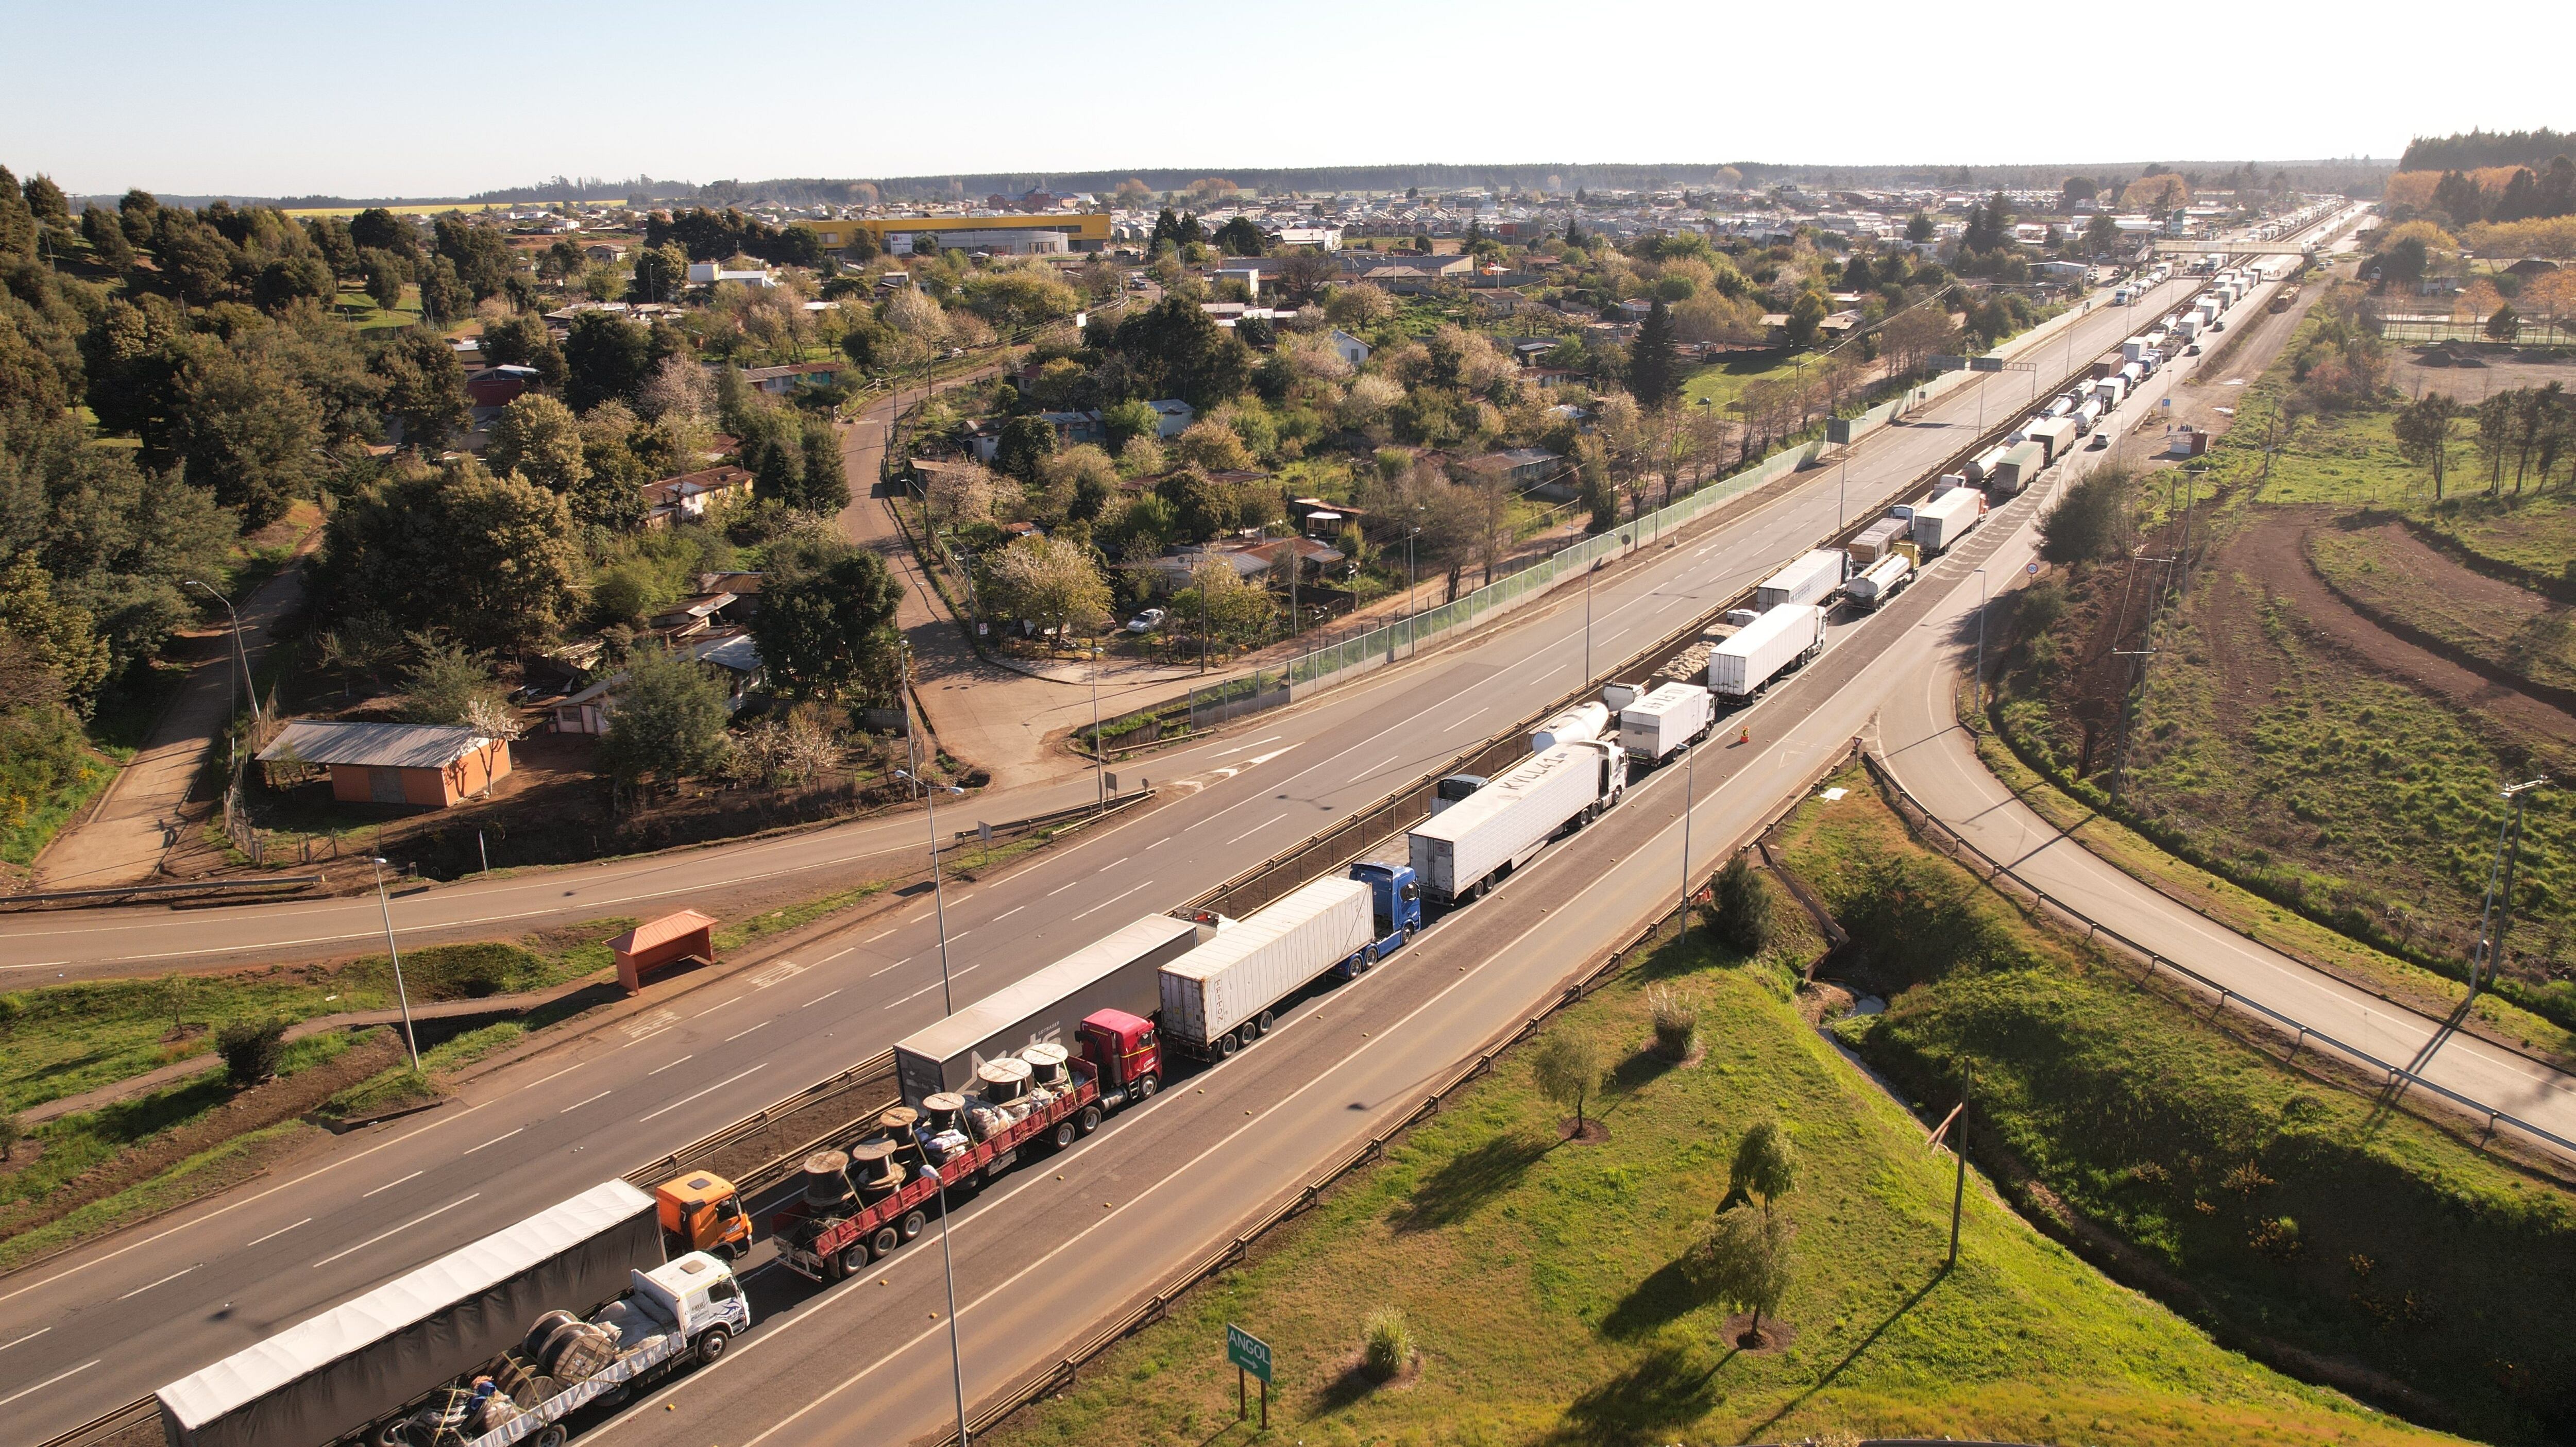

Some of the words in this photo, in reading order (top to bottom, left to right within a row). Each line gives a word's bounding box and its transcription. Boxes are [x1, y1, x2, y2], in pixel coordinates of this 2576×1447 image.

[1499, 758, 1565, 790] KYLL41
[1215, 979, 1224, 1020] TRITON
[1037, 1020, 1060, 1036] SOTRASER
[1229, 1330, 1270, 1365] ANGOL
